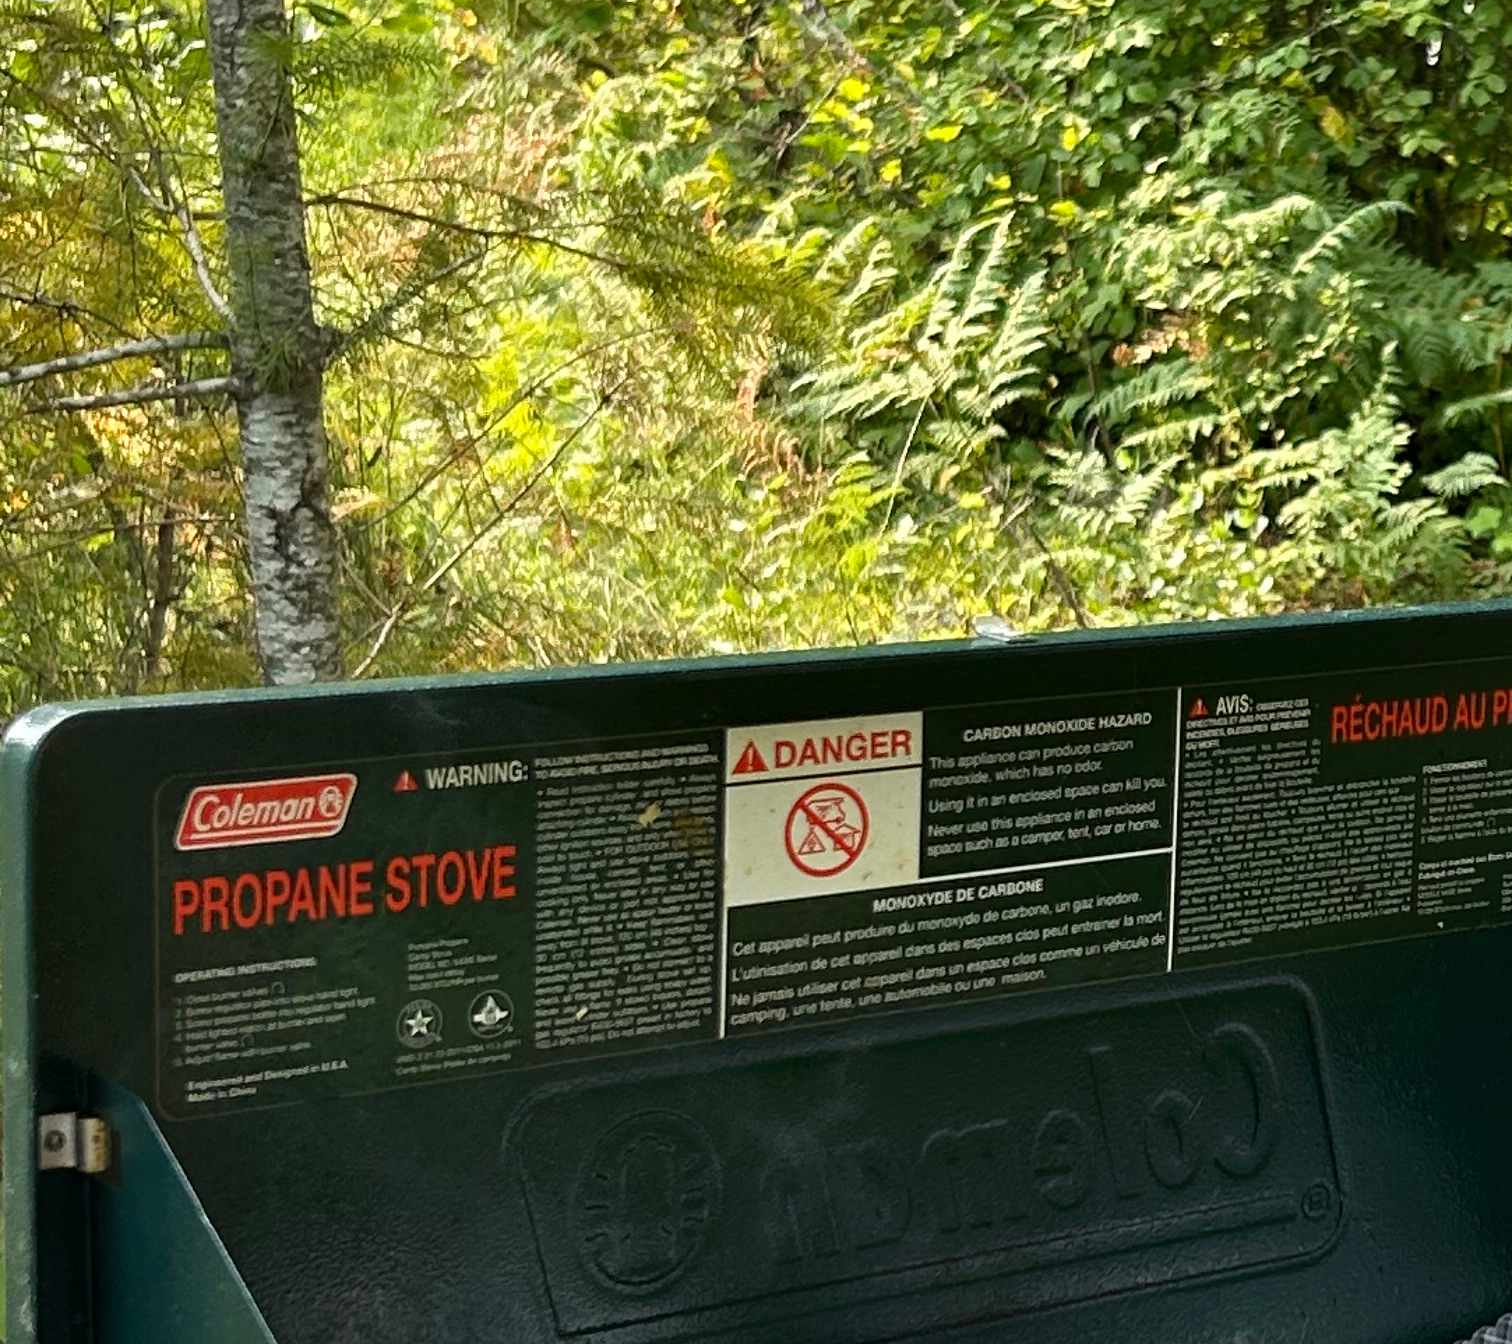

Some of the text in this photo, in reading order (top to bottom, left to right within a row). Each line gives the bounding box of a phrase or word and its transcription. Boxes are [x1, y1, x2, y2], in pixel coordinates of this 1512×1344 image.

[1216, 694, 1254, 715] AVIS:
[1331, 693, 1448, 743] RÉCHAUD
[1453, 692, 1486, 730] AU
[963, 712, 1152, 742] CARBON MONOXIDE HAZARD
[773, 729, 913, 769] DANGER
[929, 756, 955, 769] This
[1018, 748, 1041, 759] can
[1043, 743, 1091, 760] produce
[425, 759, 530, 790] WARNING:
[1032, 764, 1054, 777] has
[1056, 763, 1072, 775] no
[192, 790, 314, 832] Coleman
[928, 798, 964, 814] Using
[1064, 784, 1100, 800] space
[1102, 782, 1123, 794] can
[1125, 777, 1142, 791] kill
[927, 822, 964, 837] Never
[1104, 799, 1156, 816] enclosed
[965, 836, 993, 852] such
[1094, 824, 1112, 836] car
[173, 845, 517, 935] PROPANE STOVE
[872, 878, 1044, 913] MONOXYDE DE CARBONE
[732, 941, 755, 956] Cet
[897, 921, 915, 935] du
[983, 909, 999, 923] de
[1055, 901, 1071, 914] un
[1072, 898, 1094, 914] gaz
[731, 991, 751, 1007] Ne
[1151, 932, 1166, 946] de
[810, 957, 828, 971] de
[939, 939, 961, 954] des
